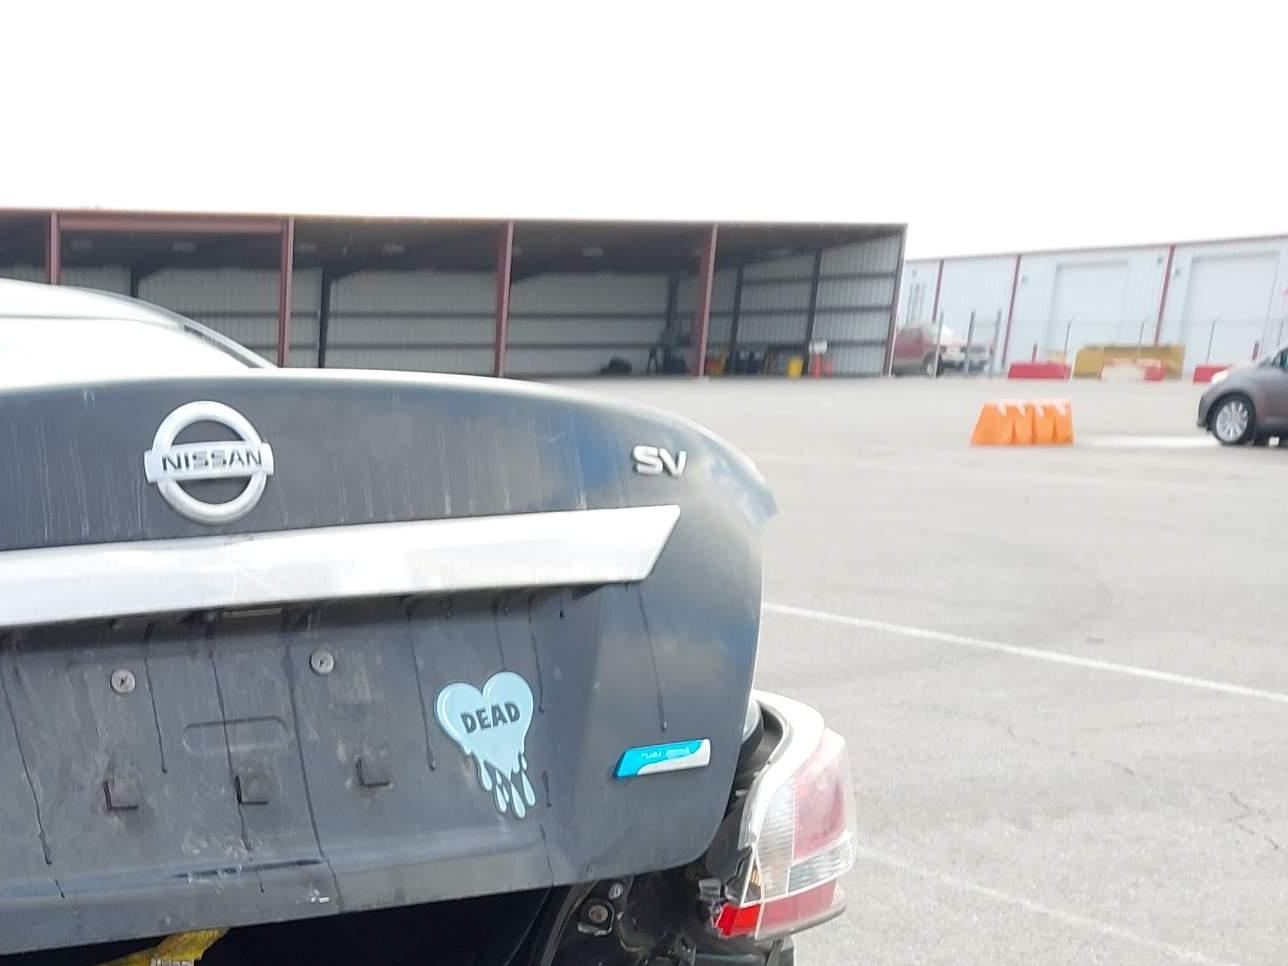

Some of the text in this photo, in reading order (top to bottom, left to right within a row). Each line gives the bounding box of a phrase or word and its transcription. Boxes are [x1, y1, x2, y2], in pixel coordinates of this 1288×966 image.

[161, 448, 262, 472] NISSAN
[631, 445, 688, 478] SV
[459, 701, 521, 734] DEAD
